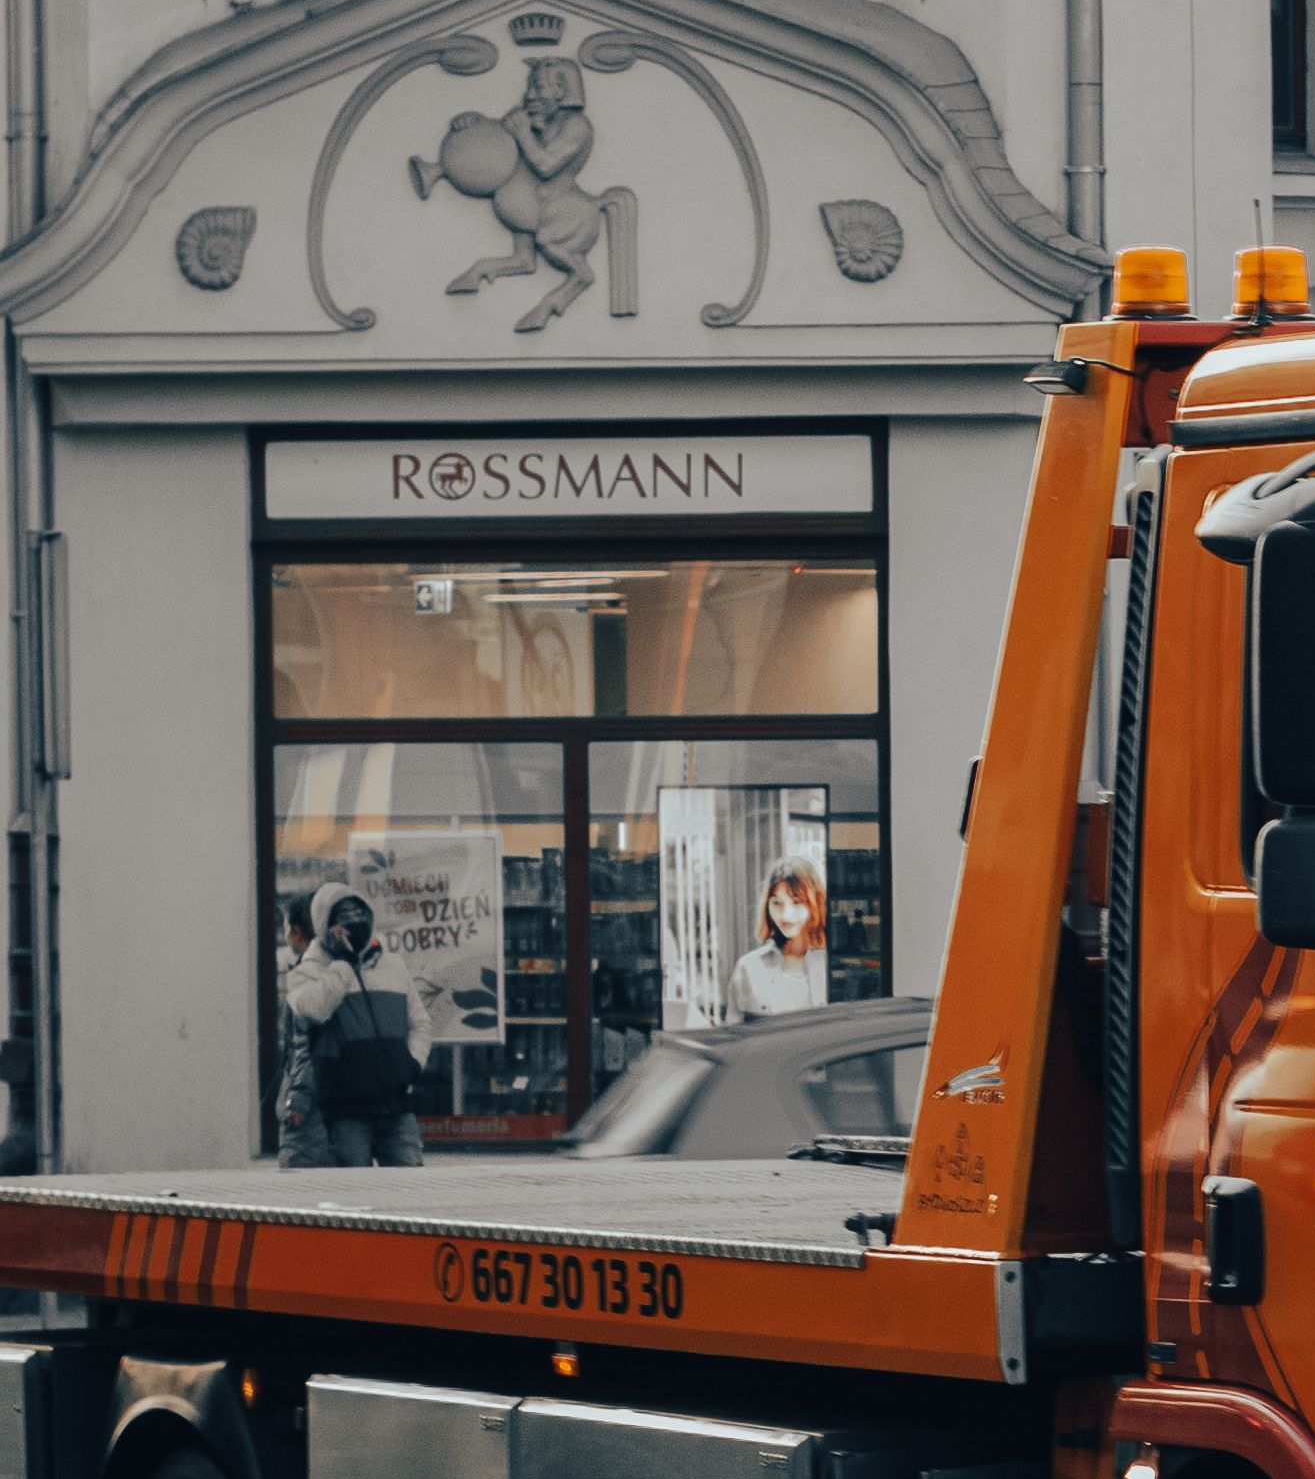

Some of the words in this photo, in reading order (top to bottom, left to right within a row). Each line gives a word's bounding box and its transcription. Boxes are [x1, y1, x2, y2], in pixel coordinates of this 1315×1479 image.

[392, 451, 743, 501] ROSSMANN
[385, 924, 462, 953] DOBRY
[471, 1247, 532, 1305] 667
[539, 1252, 585, 1310] 30
[591, 1257, 629, 1314] 13
[637, 1261, 684, 1319] 30
